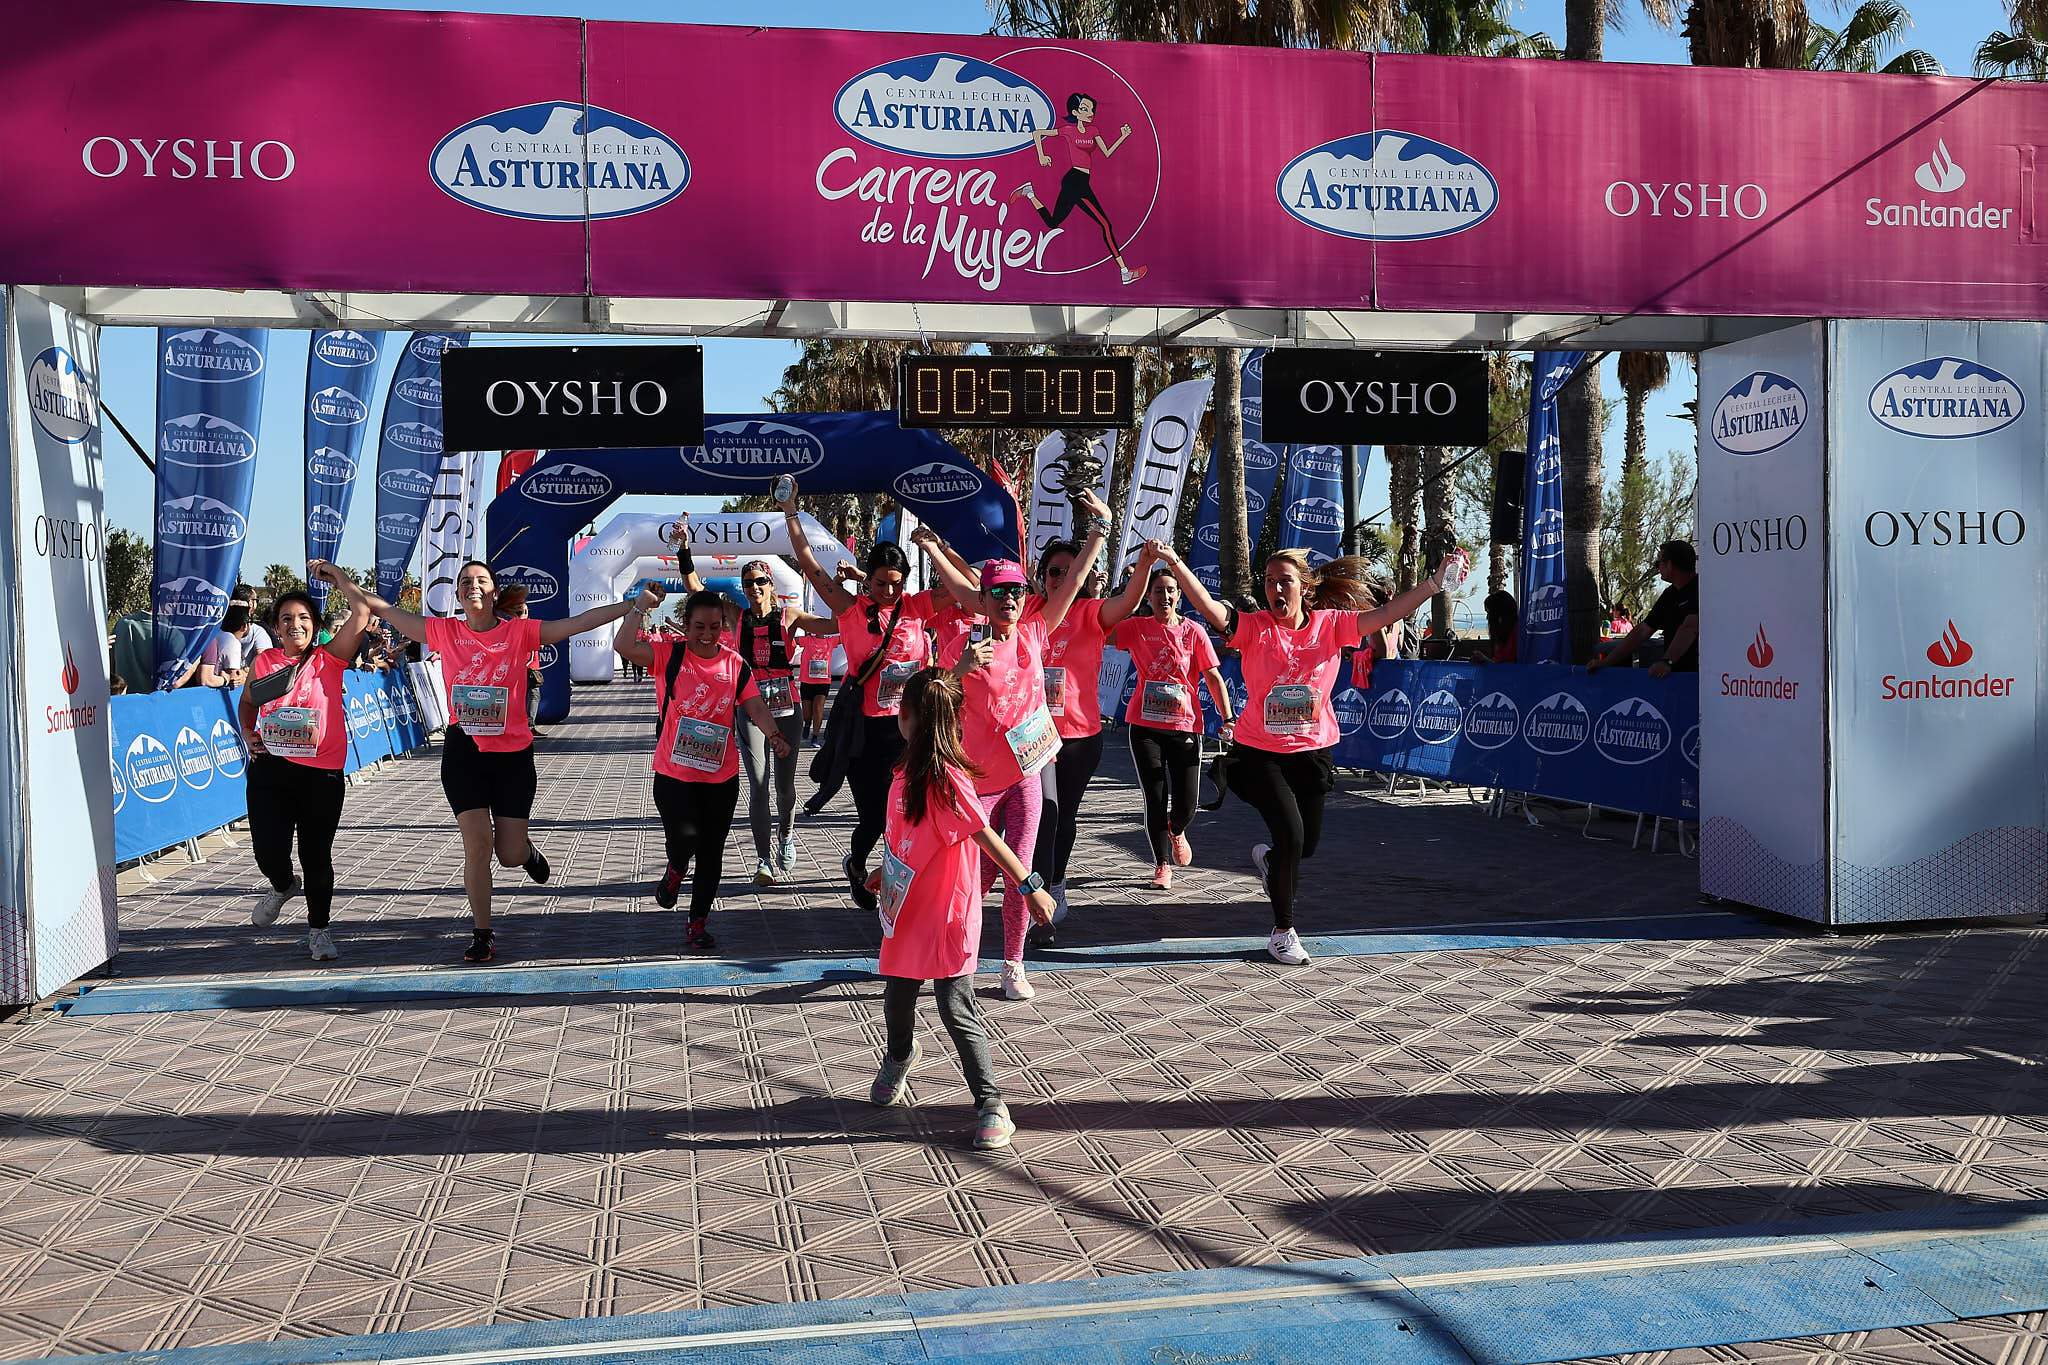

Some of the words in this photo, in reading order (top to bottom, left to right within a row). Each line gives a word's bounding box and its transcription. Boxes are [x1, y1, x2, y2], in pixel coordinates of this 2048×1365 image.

[886, 87, 955, 100] CENTRAL
[961, 90, 1031, 103] LECHERA
[851, 88, 1036, 133] ASTURIANA
[82, 136, 296, 181] OYSHO
[491, 141, 572, 155] CENTRAL
[451, 143, 672, 190] ASTURIANA
[815, 147, 997, 207] Carrera
[1329, 167, 1398, 179] CENTRAL
[1405, 169, 1475, 181] LECHERA
[1295, 168, 1482, 213] ASTURIANA
[1604, 181, 1768, 220] OYSHO
[1866, 197, 2013, 229] Santander
[861, 205, 895, 244] de
[902, 204, 926, 245] la
[921, 202, 1065, 292] Mujer
[165, 345, 253, 372] ASTURIANA
[319, 340, 370, 361] ASTURIANA
[34, 373, 91, 425] ASTURIANA
[399, 383, 442, 404] ASTURIA
[486, 380, 668, 417] OYSHO
[917, 368, 1116, 415] 00:57:08
[1300, 379, 1457, 416] OYSHO
[1730, 398, 1761, 412] CENTRAL
[1762, 393, 1797, 407] LECHERA
[1880, 387, 2012, 418] ASTURIANA
[1903, 385, 1953, 394] CENTRAL
[1957, 385, 2008, 394] LECHERA
[1717, 404, 1801, 440] ASTURIANA
[691, 443, 814, 464] ASTURIANA
[713, 437, 759, 445] CENTRAL
[763, 437, 808, 445] LECHERA
[383, 475, 431, 494] ASTURIAN
[526, 478, 605, 495] ASTURIANA
[901, 479, 977, 494] ASTURIANA
[1125, 415, 1189, 557] YSHO
[35, 515, 97, 562] OYSHO
[427, 451, 465, 617] OYSH
[1713, 514, 1807, 556] OYSHO
[1865, 510, 2026, 547] OYSHO
[590, 548, 624, 556] OYSHO
[811, 544, 836, 553] YSHO
[575, 593, 608, 602] OYSHO
[575, 639, 608, 648] OYSHO
[1721, 673, 1799, 700] Santander
[1882, 674, 2014, 700] Santander
[46, 702, 97, 734] Santander
[1416, 708, 1457, 731] ASTURIANA
[1467, 711, 1513, 736] ASTURIANA
[1527, 714, 1583, 741] ASTURIANA
[1598, 720, 1661, 751] ASTURIANA
[130, 763, 176, 789] ASTURIANA
